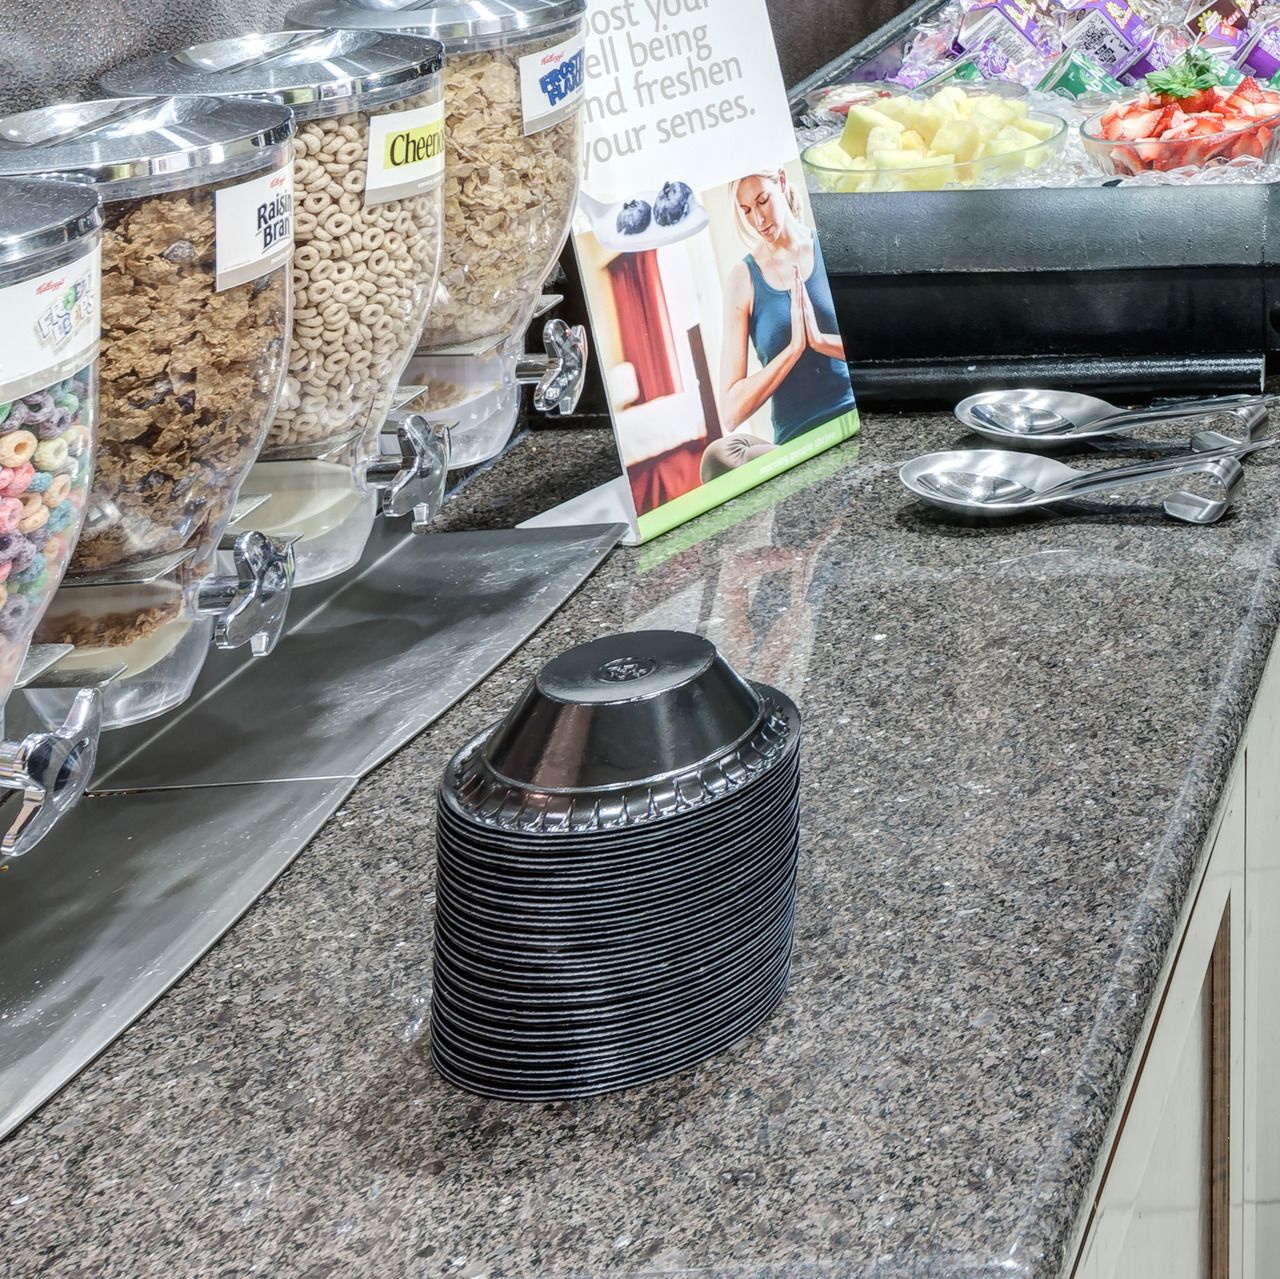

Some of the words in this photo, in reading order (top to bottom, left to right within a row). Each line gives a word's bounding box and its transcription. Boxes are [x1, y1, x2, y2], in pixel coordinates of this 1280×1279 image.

[585, 36, 619, 79] ell
[626, 24, 712, 67] being
[583, 77, 628, 124] nd
[633, 56, 743, 107] freshen
[656, 95, 755, 144] senses.
[257, 189, 292, 231] Raisin
[263, 217, 290, 249] Bran
